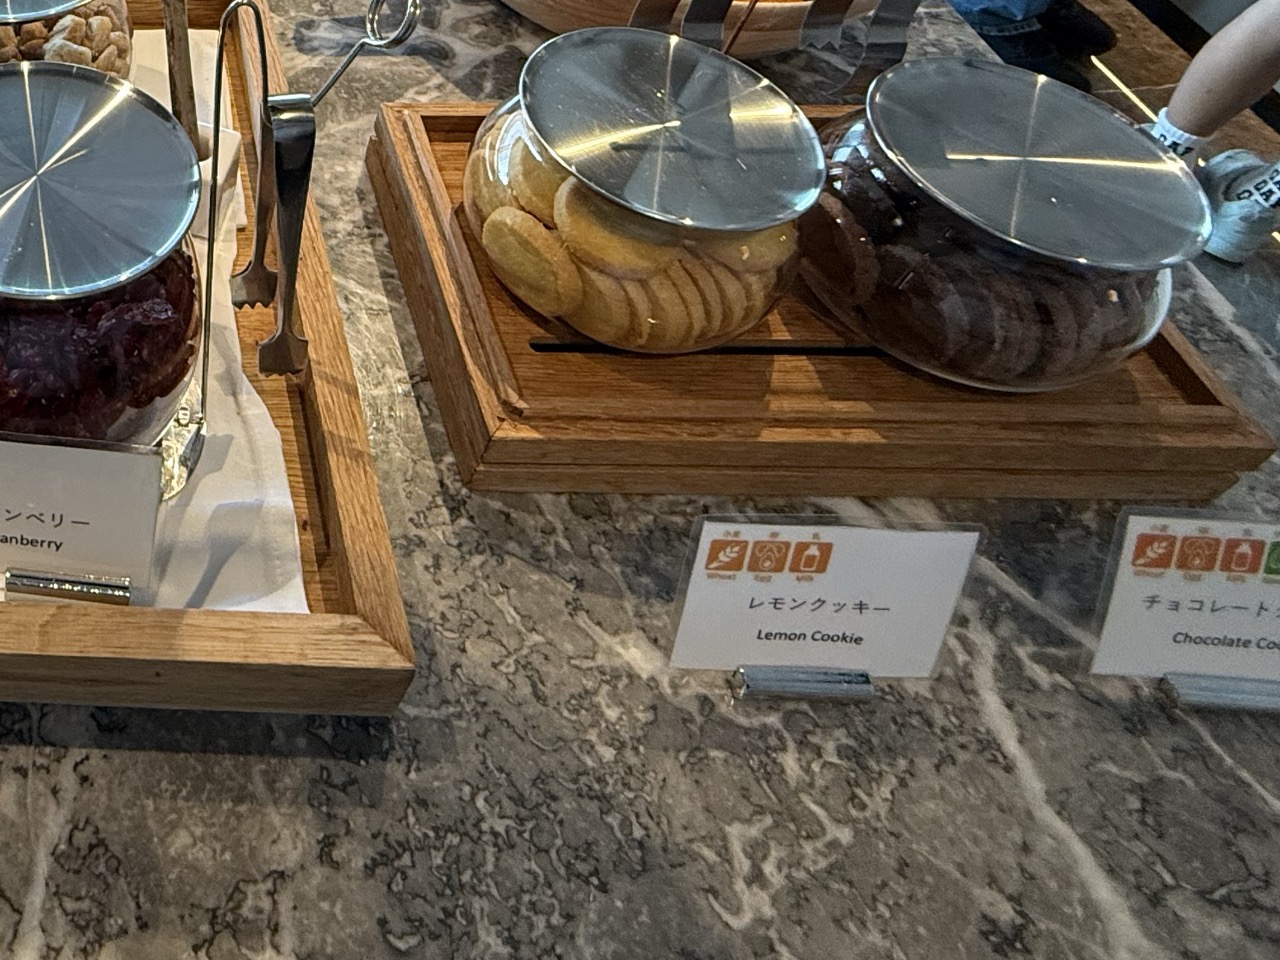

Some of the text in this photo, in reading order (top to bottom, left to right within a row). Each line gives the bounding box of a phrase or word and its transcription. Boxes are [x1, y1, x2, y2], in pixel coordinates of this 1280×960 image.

[748, 596, 892, 616] レモンクッキー
[1141, 594, 1280, 619] チョコレート
[756, 629, 865, 646] Lemon Cookie
[1172, 631, 1253, 649] Chocolate
